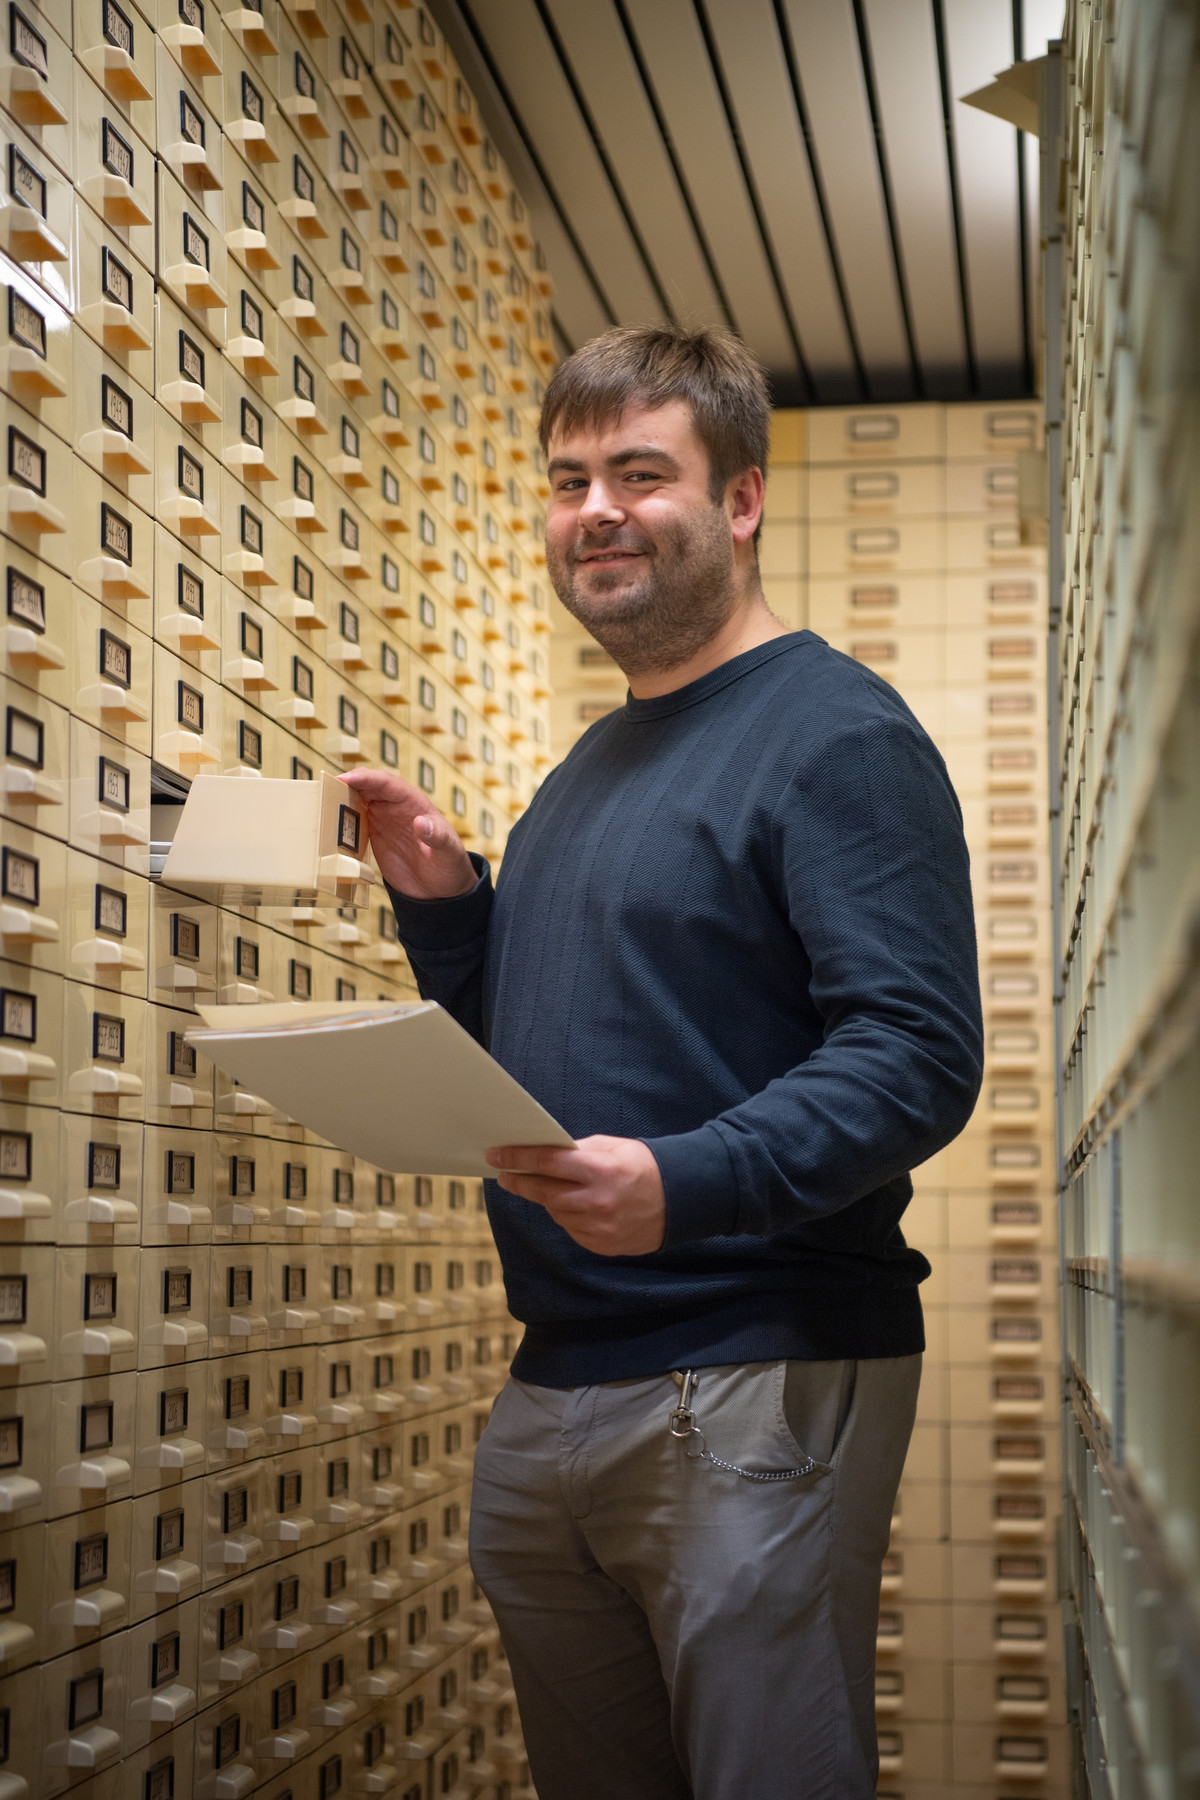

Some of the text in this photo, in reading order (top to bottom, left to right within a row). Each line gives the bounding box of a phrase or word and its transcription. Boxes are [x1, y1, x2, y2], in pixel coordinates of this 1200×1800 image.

[111, 262, 122, 297] 1943
[110, 393, 122, 424] 1943
[19, 445, 33, 477] 1905
[107, 770, 119, 798] 1953
